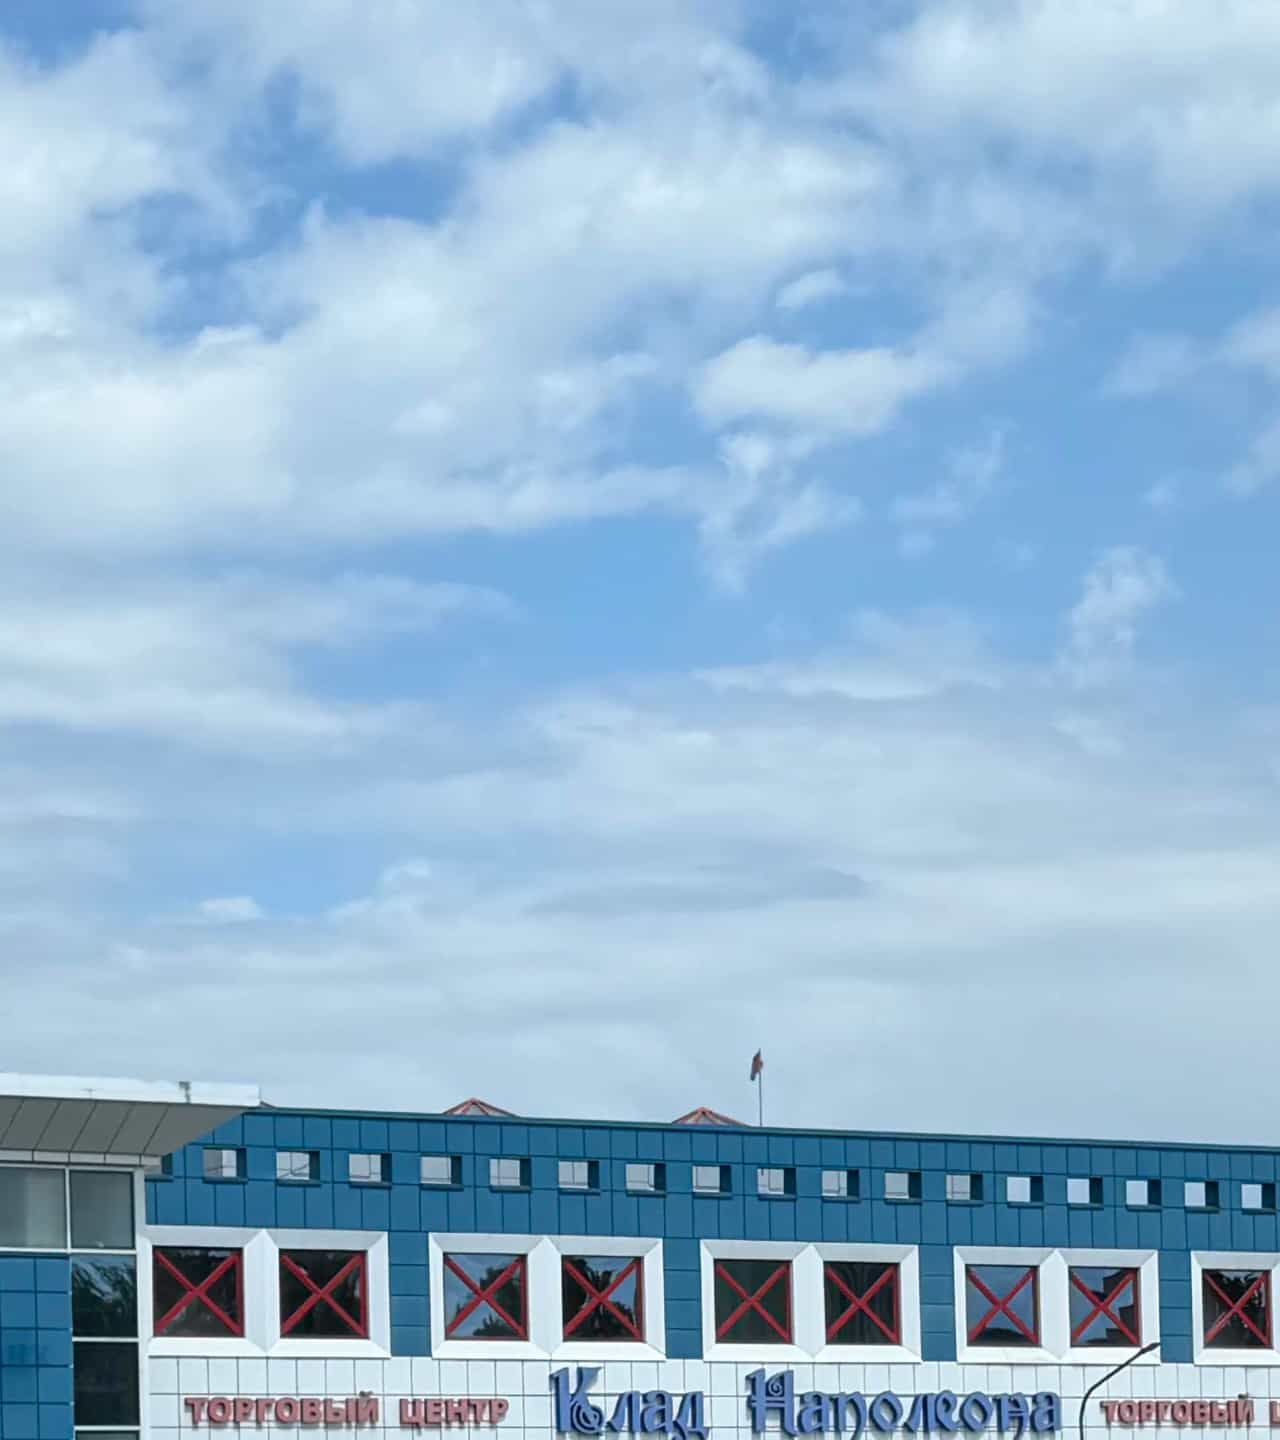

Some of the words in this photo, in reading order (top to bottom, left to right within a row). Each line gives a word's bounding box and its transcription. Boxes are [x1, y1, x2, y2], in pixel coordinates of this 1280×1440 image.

[185, 1391, 379, 1427] ТОРГОВЫЙ
[399, 1397, 509, 1430] ЦЕНТР
[1100, 1393, 1254, 1427] ТОРГОВЫЙ
